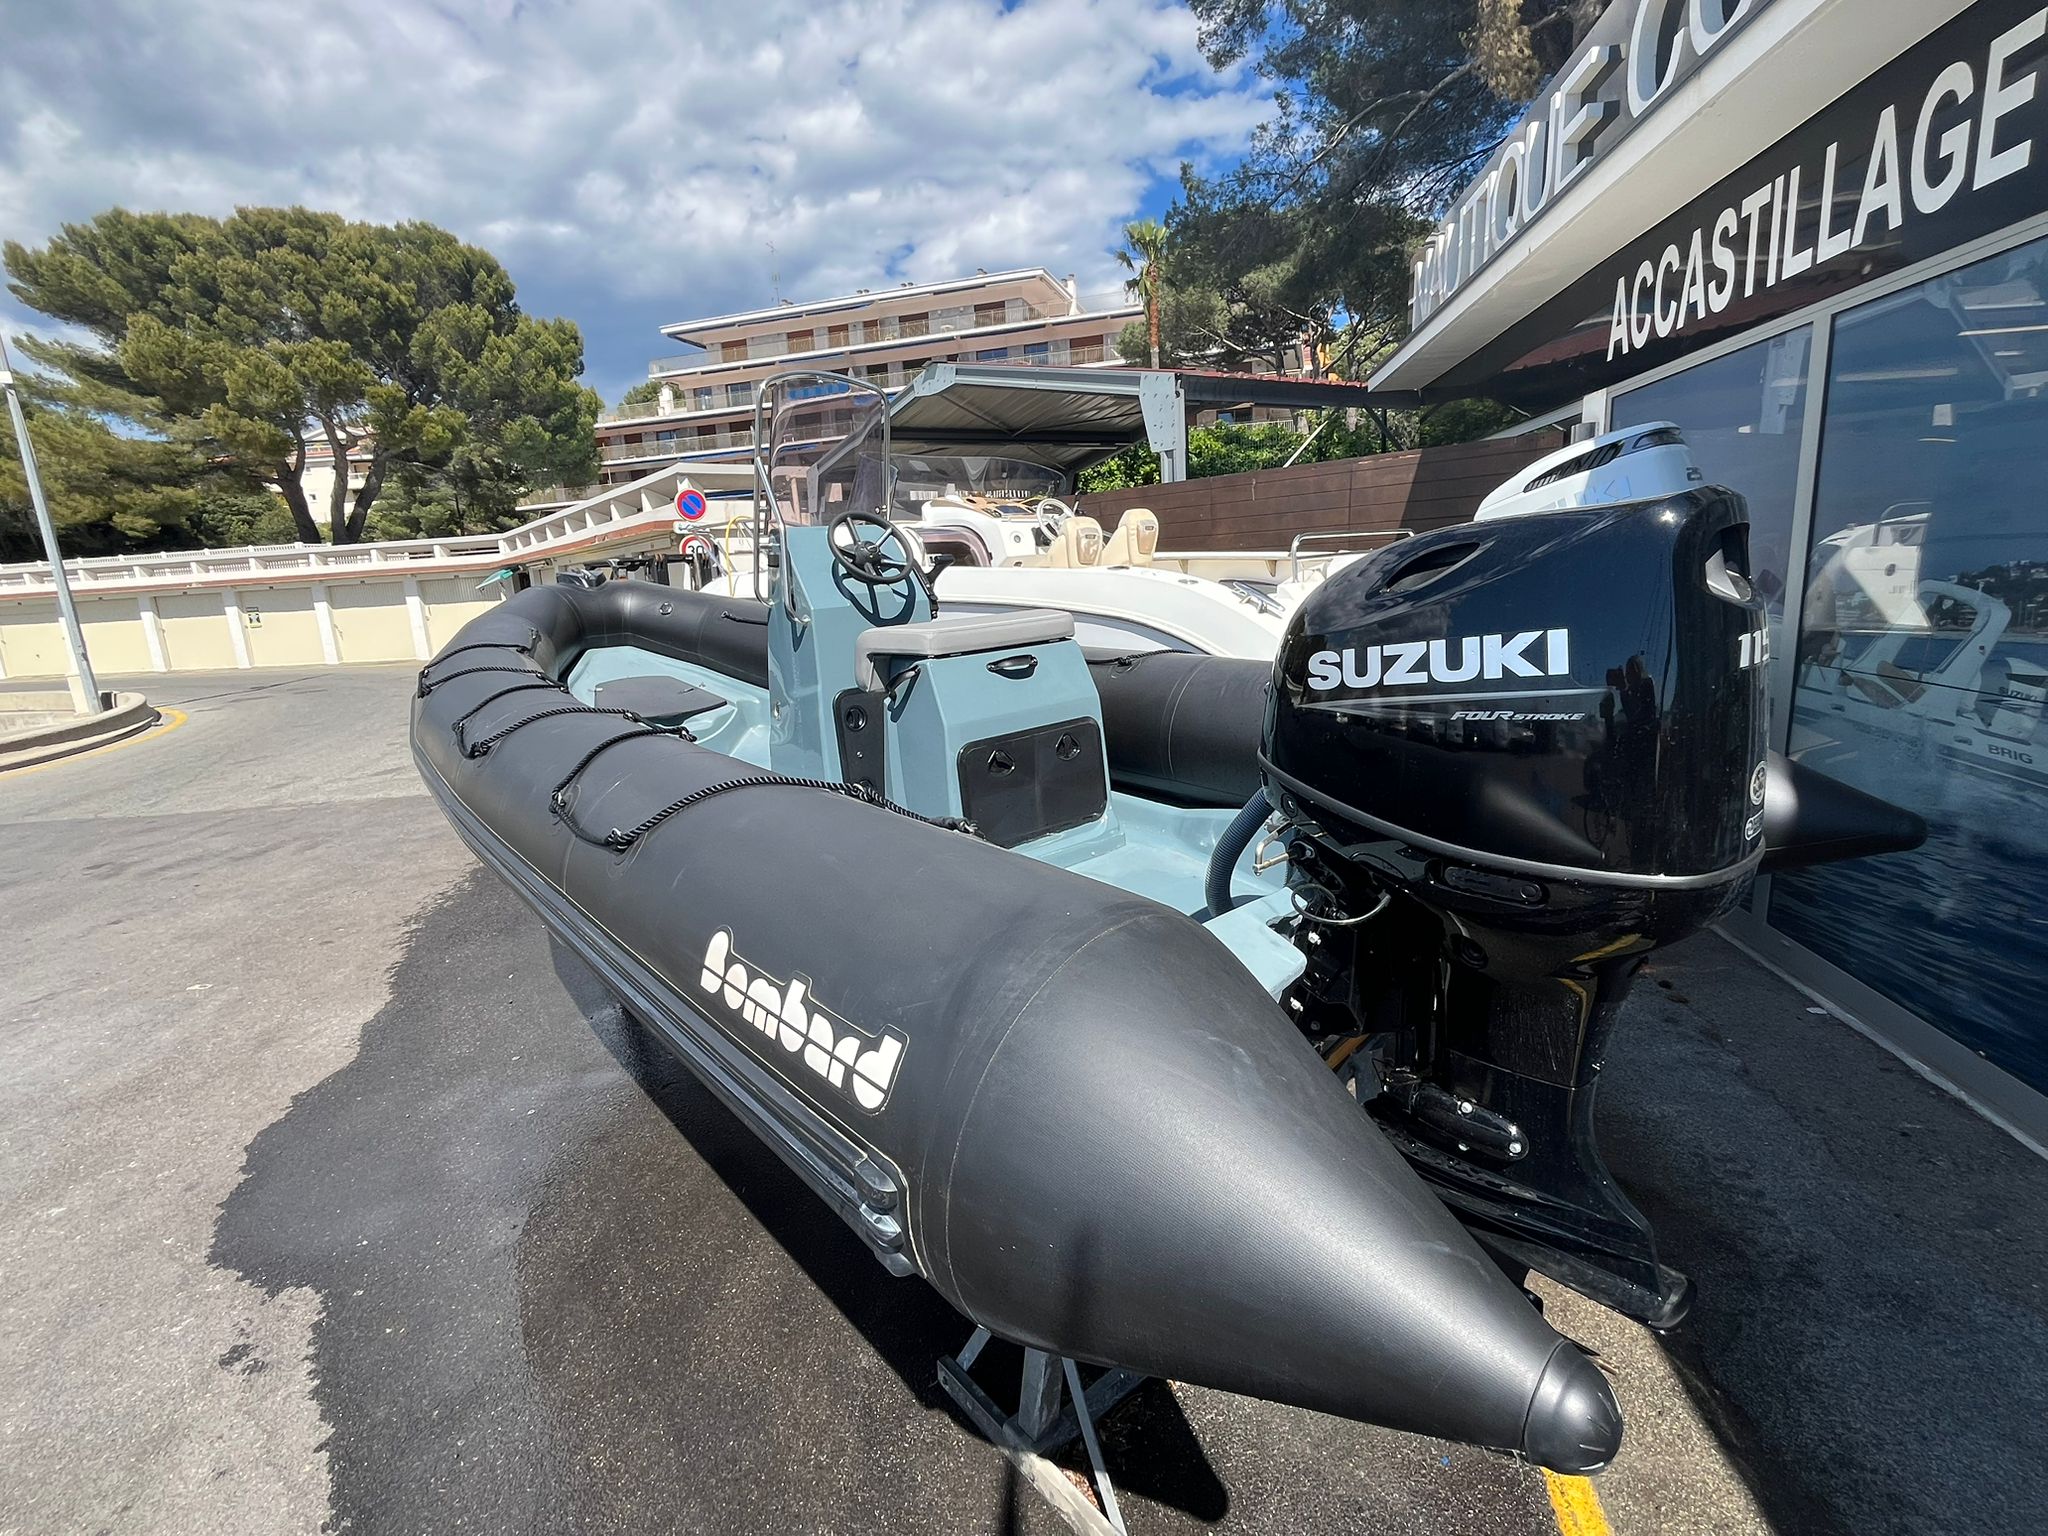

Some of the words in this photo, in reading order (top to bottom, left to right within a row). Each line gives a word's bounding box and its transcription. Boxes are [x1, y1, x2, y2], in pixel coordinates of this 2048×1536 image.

[1606, 8, 2048, 362] ACCASTILLAGE
[1307, 628, 1570, 691] SUZUKI
[1988, 744, 2033, 765] BRIG
[700, 930, 902, 1109] bombard
